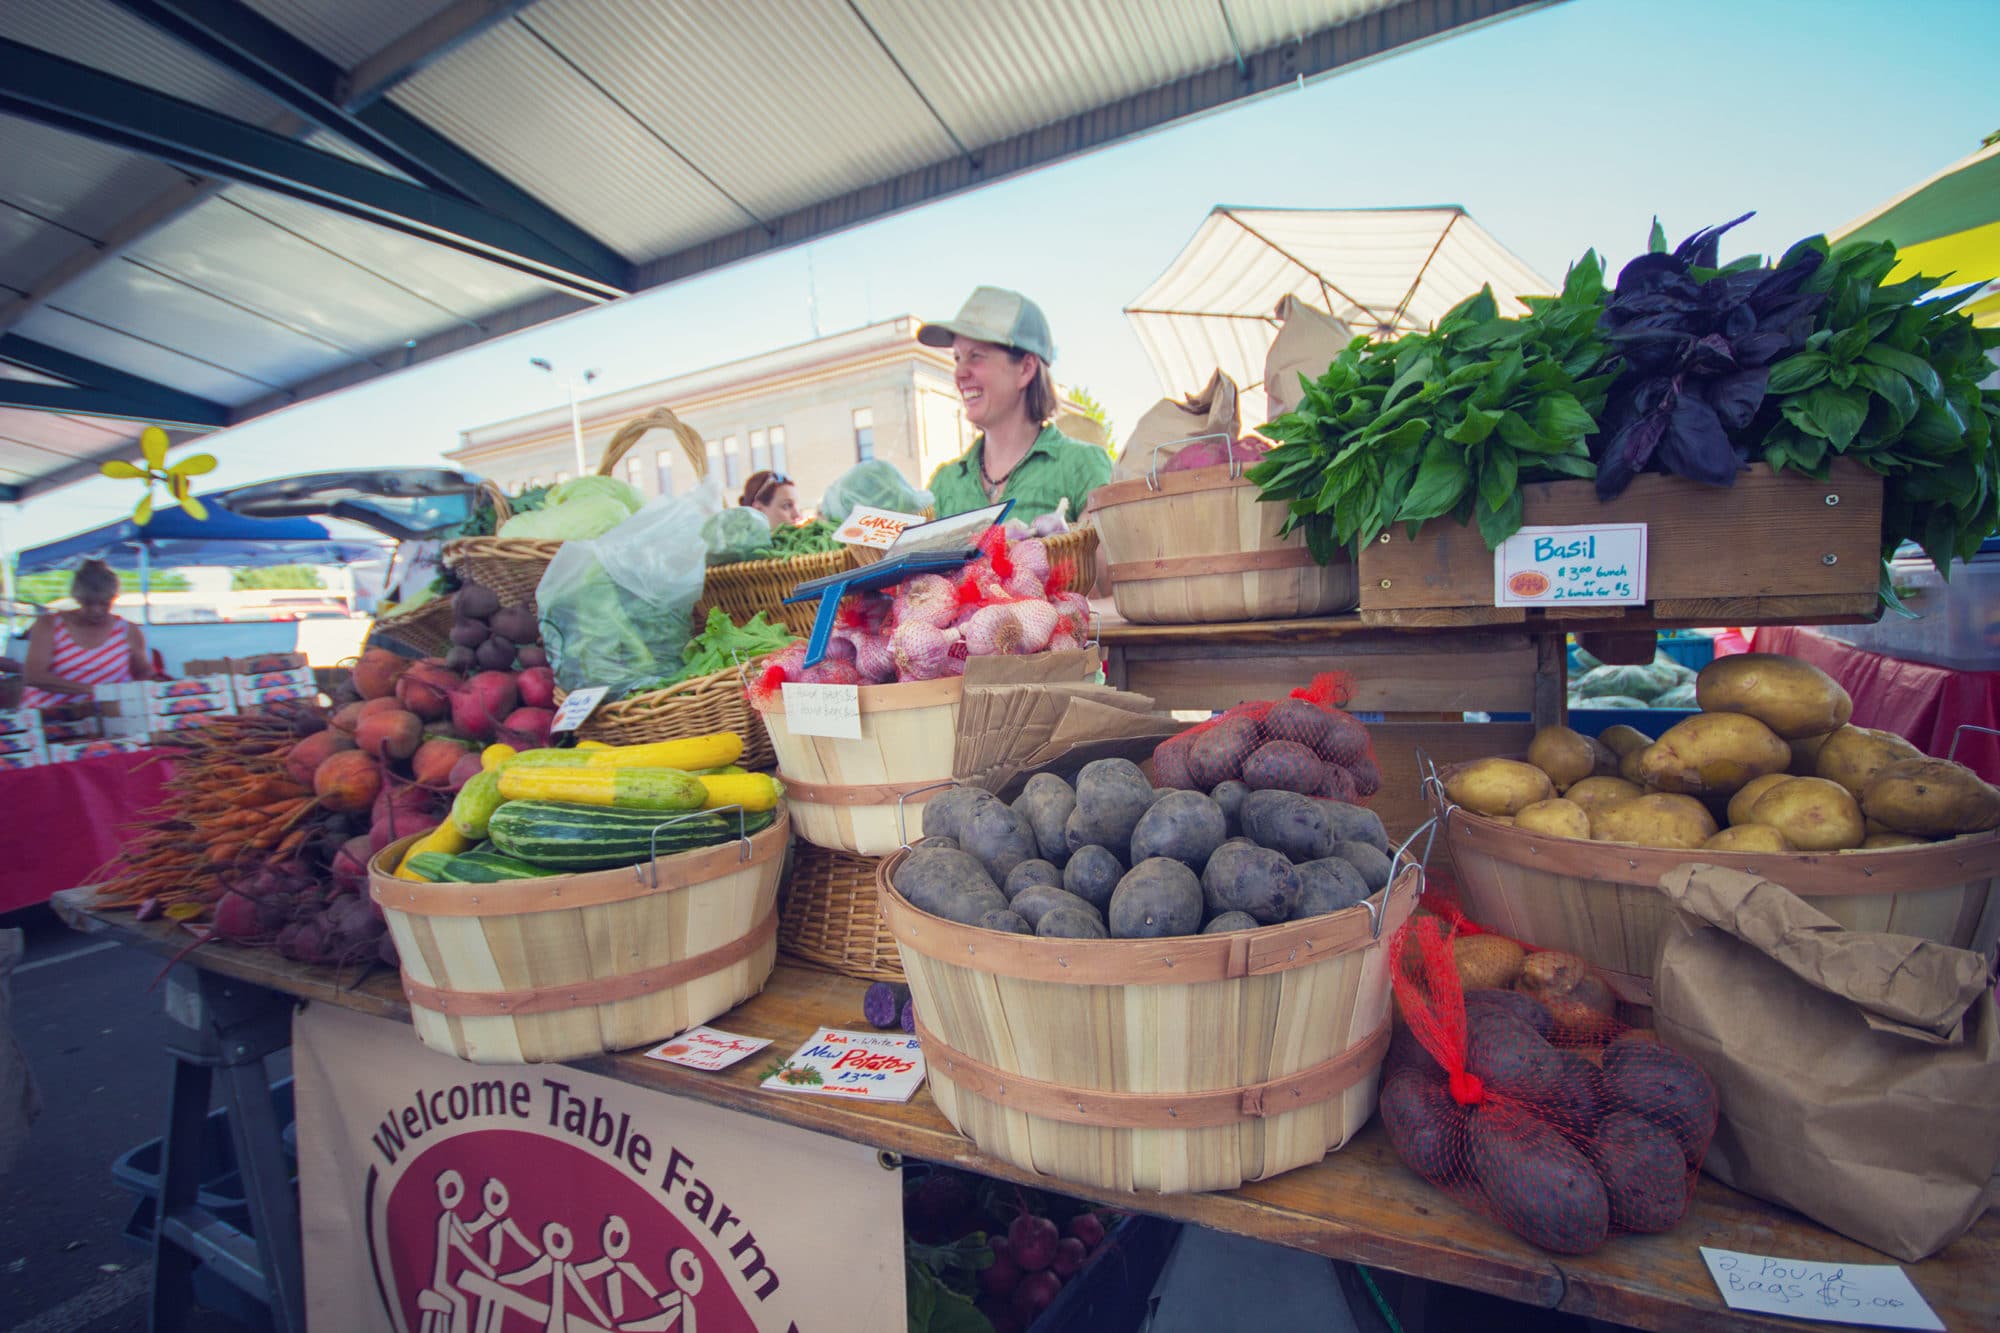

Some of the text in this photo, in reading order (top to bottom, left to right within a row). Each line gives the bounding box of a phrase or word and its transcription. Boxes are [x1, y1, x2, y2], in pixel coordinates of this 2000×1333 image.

[1534, 535, 1595, 562] Basil
[1553, 587, 1565, 599] 2
[1595, 586, 1610, 597] for
[1615, 583, 1630, 597] $5
[802, 1045, 842, 1059] New
[824, 1033, 848, 1045] Red
[860, 1037, 894, 1048] White
[371, 1078, 780, 1302] Welcome Table Farm
[1760, 1257, 1846, 1283] Pound
[1729, 1272, 1804, 1303] Bags
